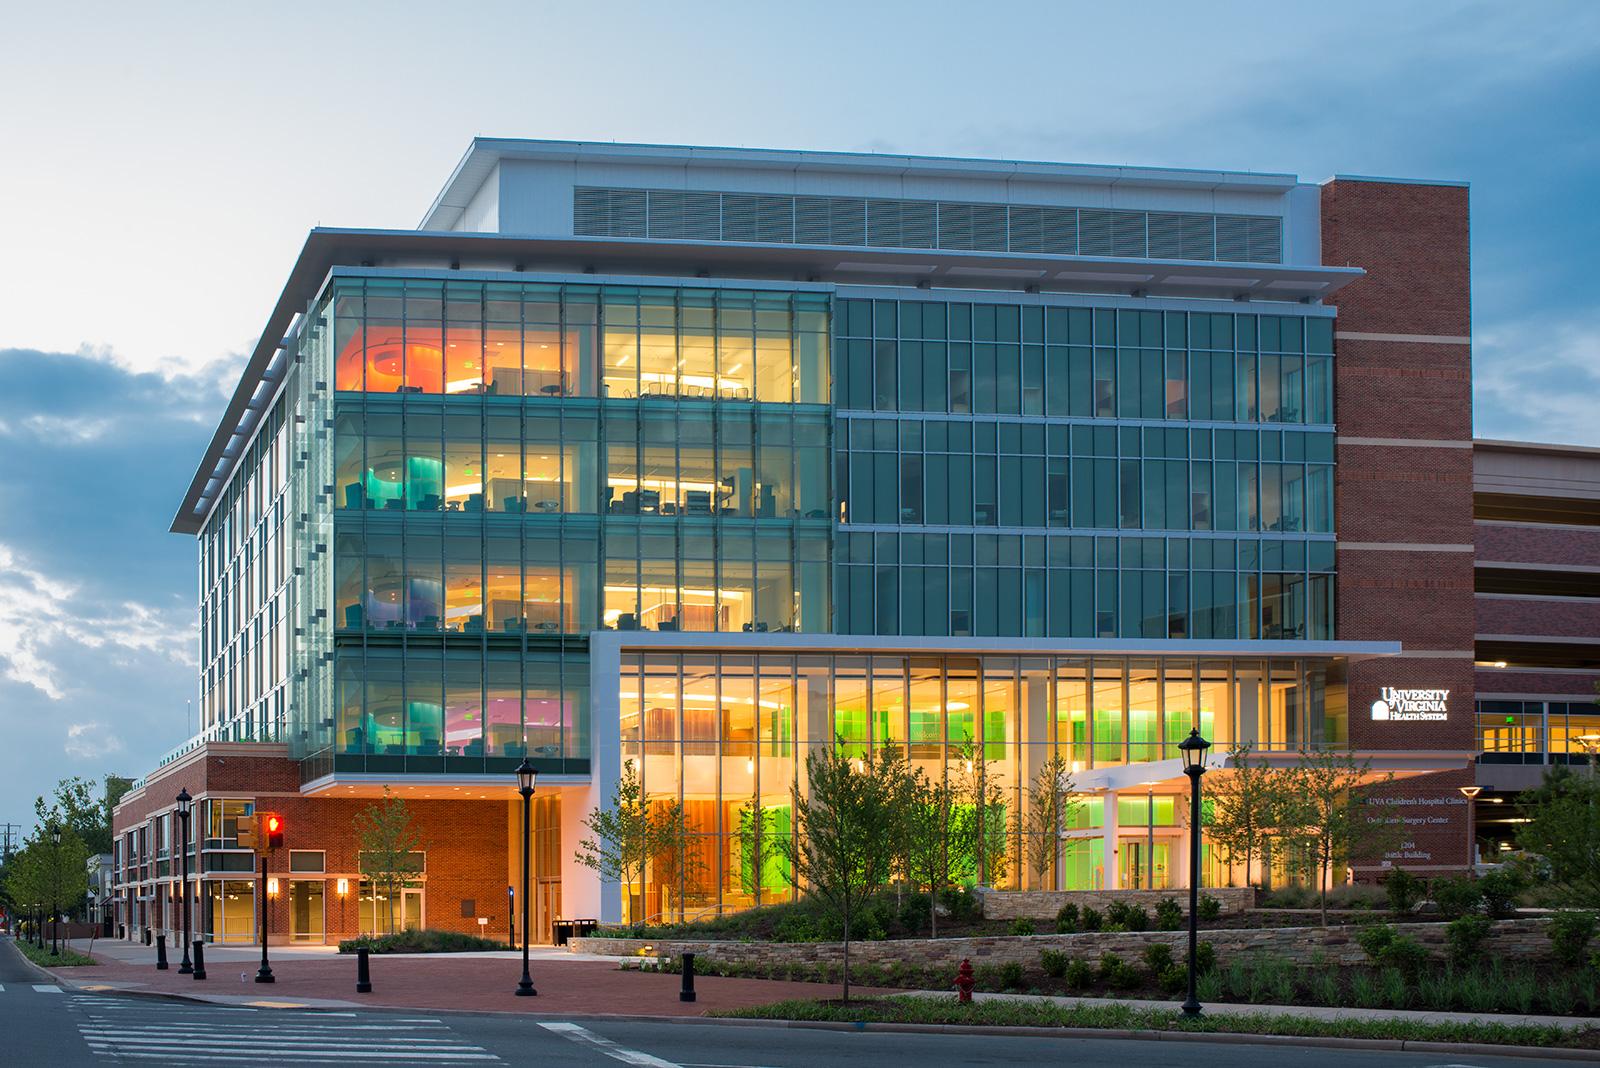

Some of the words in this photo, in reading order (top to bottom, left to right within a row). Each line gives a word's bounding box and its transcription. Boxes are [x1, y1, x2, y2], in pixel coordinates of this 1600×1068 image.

[1381, 687, 1450, 701] UNIVERSITY
[1396, 700, 1447, 713] VIRGINIA
[1390, 711, 1419, 720] HEALTH
[1420, 711, 1447, 720] SYSTEM
[1418, 797, 1444, 806] Hospital
[1445, 797, 1468, 805] Clinics
[1401, 816, 1426, 825] Surgery
[1427, 815, 1448, 824] Center
[1404, 850, 1431, 860] Building
